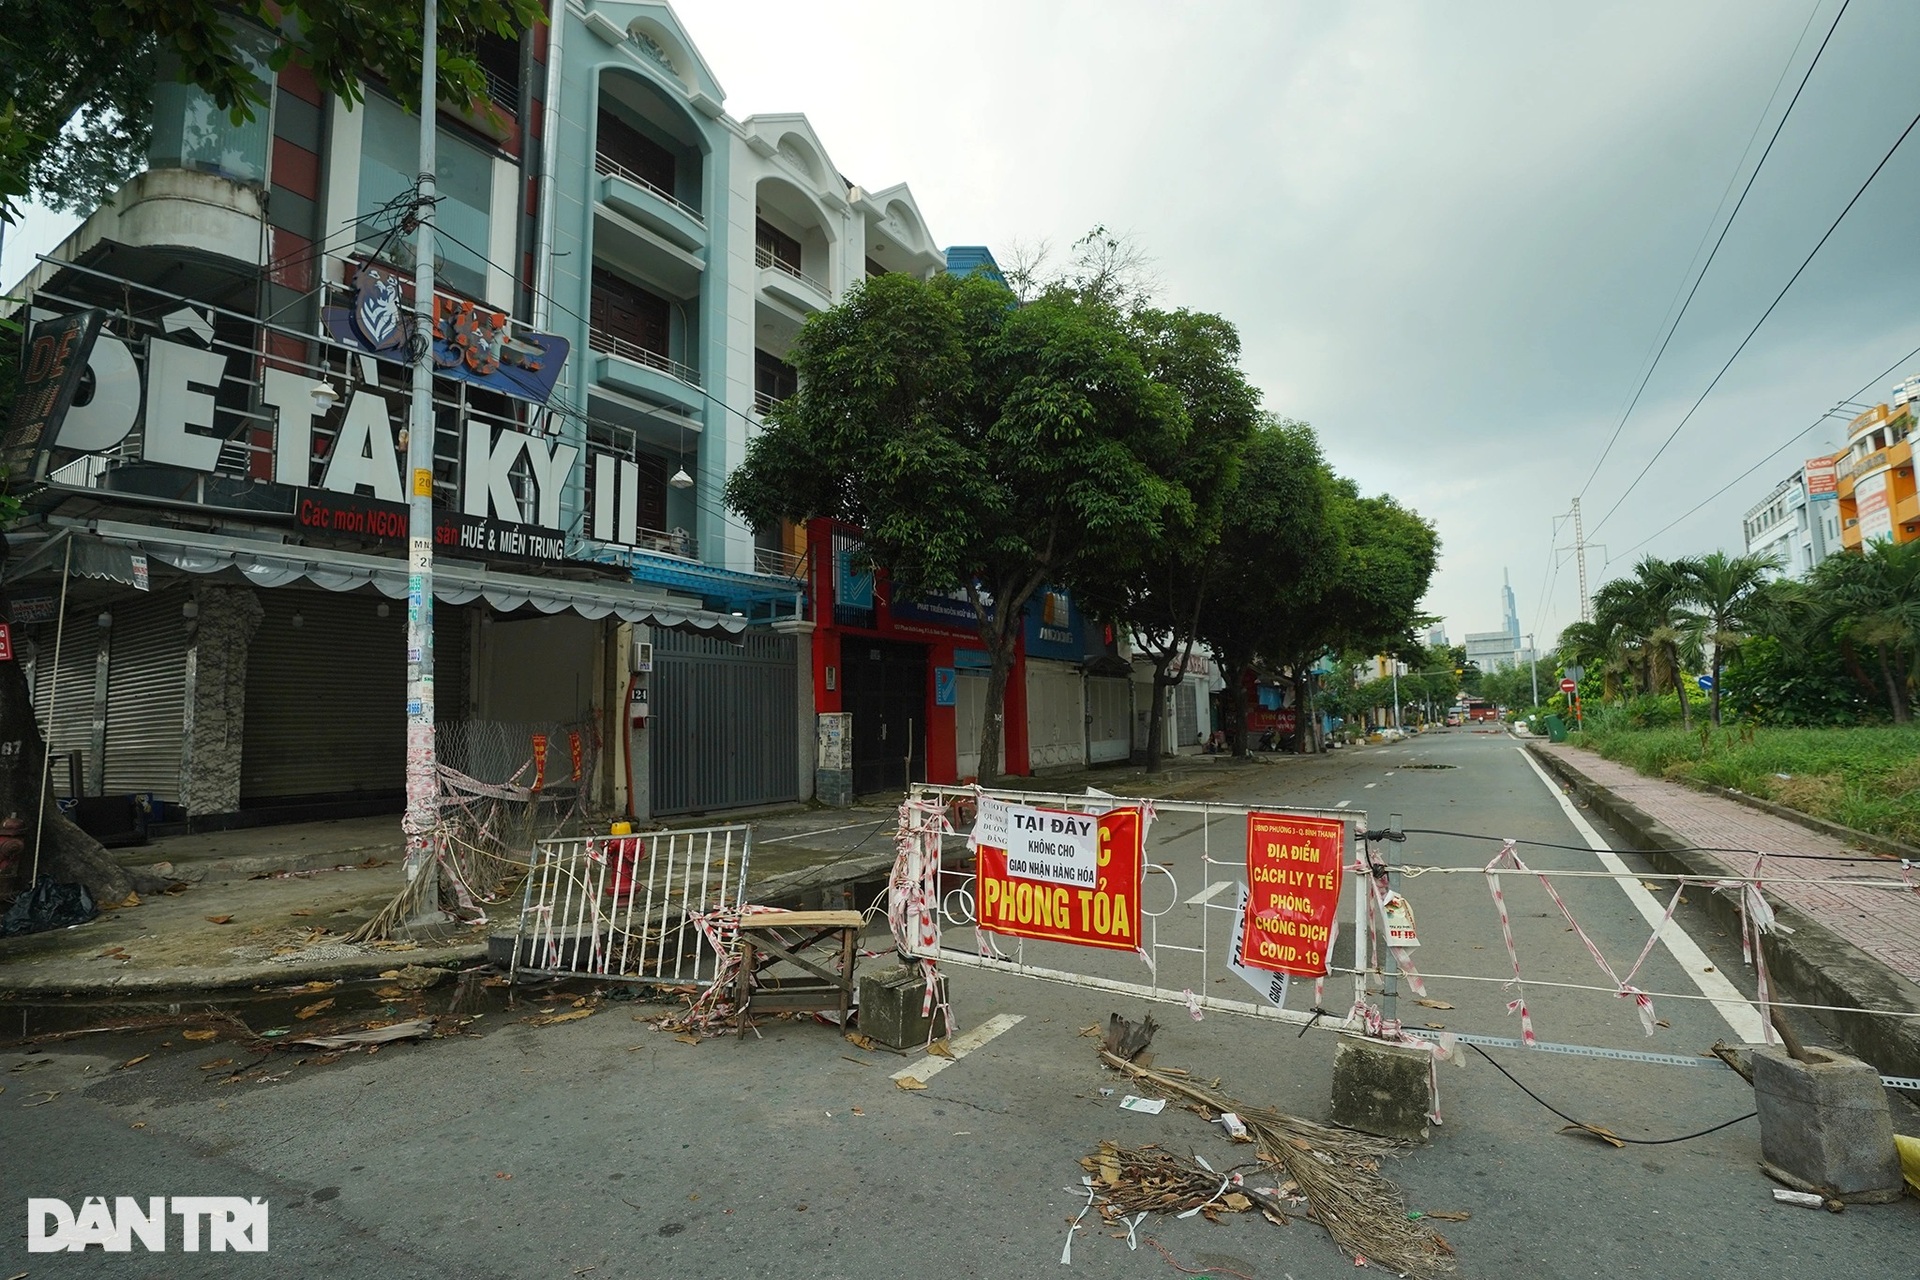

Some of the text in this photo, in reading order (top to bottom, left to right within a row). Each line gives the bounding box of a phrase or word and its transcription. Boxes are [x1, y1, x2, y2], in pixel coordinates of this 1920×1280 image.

[464, 411, 580, 530] KÝ
[301, 499, 329, 528] Các
[367, 510, 407, 537] NGON
[461, 519, 487, 549] HUẾ
[487, 529, 496, 551] &
[500, 525, 526, 555] MIỀN
[529, 535, 563, 560] TRUNG
[1013, 814, 1044, 833] TẠI
[1051, 816, 1091, 836] ĐÂY
[1028, 839, 1075, 858] KHÔNG CHO
[1267, 840, 1320, 863] ĐỊA ĐIỂM
[1009, 858, 1094, 883] GIAO NHẬN HÀNG HÓA
[1254, 864, 1334, 890] CÁCH LY Y TẾ
[984, 877, 1130, 937] PHONG TỎA
[1270, 892, 1314, 916] PHÒNG,
[1255, 913, 1328, 943] CHỐNG DỊCH
[1260, 941, 1296, 962] COVID
[1305, 950, 1319, 966] 19
